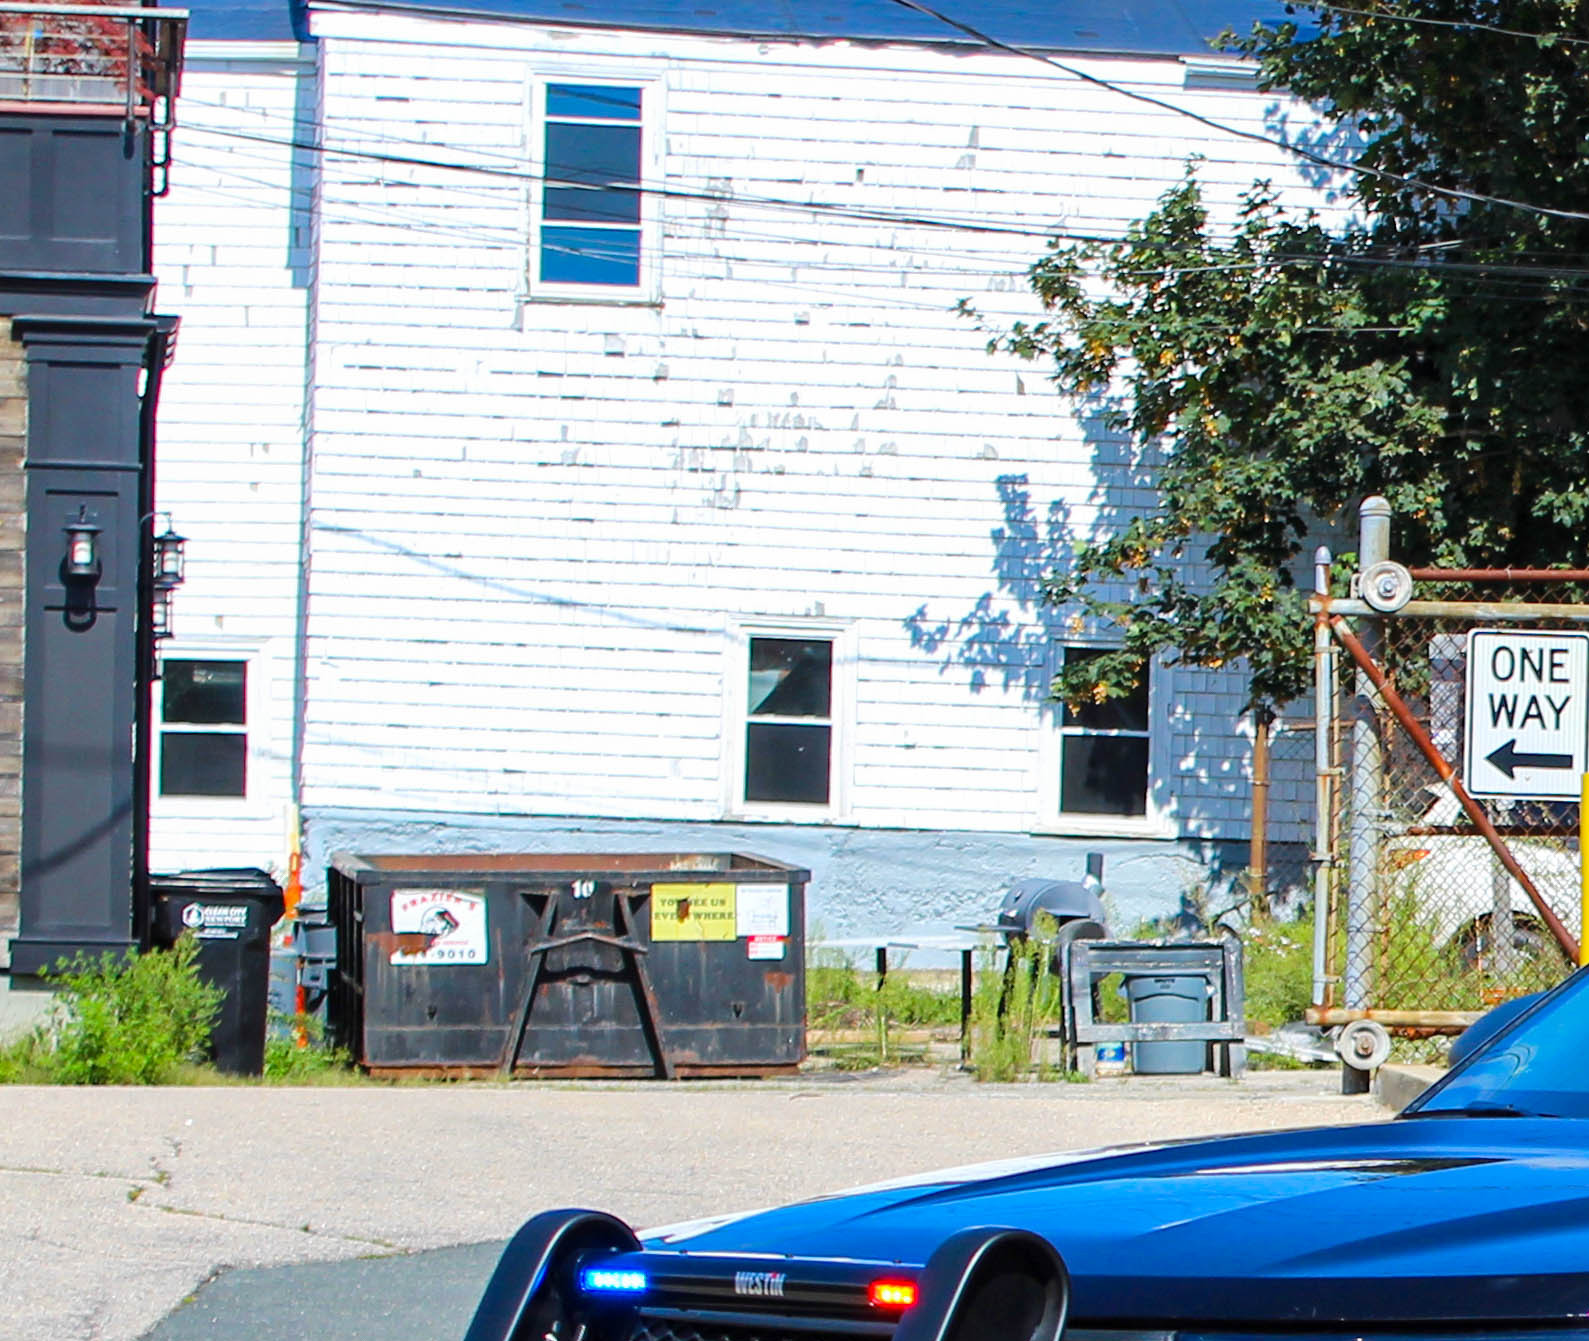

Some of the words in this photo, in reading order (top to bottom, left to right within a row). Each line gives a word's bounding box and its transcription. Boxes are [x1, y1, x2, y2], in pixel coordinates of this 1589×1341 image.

[1491, 645, 1570, 683] ONE
[1488, 692, 1572, 731] WAY
[571, 879, 595, 899] 10
[711, 899, 726, 907] US
[654, 912, 733, 921] EVEWHERE
